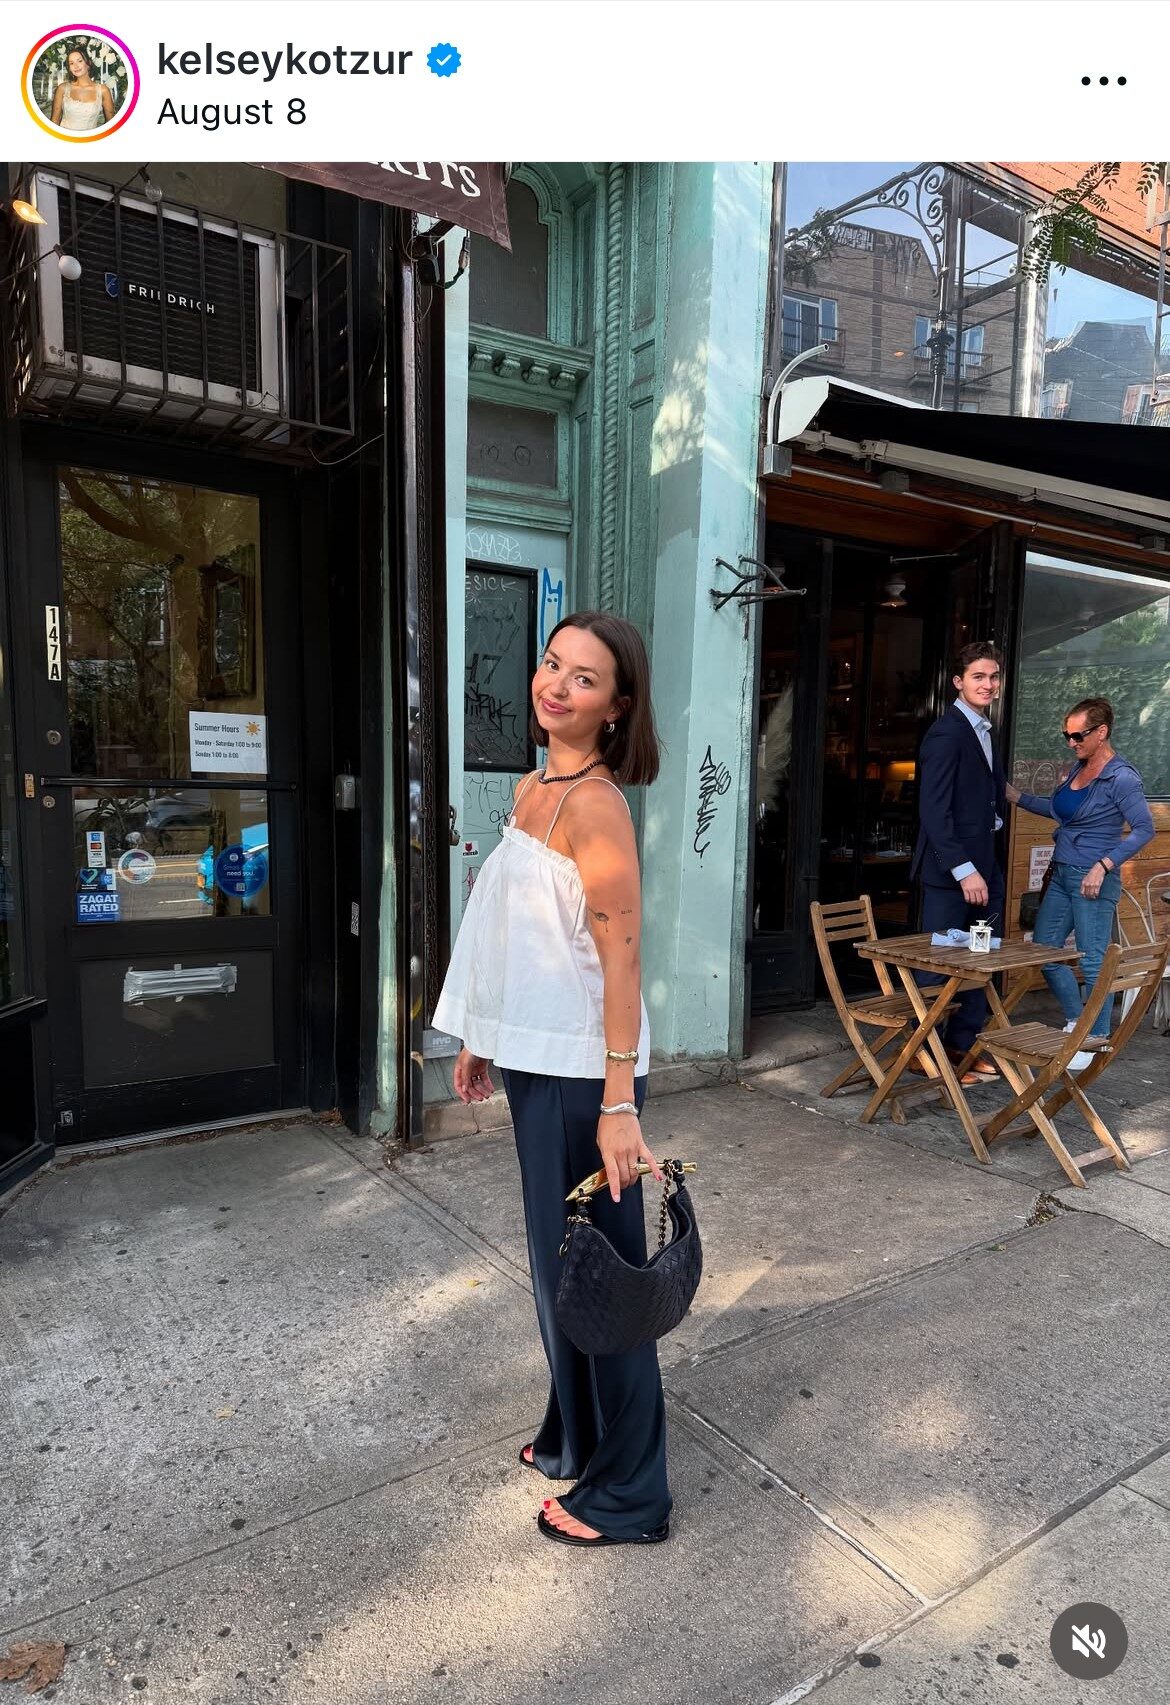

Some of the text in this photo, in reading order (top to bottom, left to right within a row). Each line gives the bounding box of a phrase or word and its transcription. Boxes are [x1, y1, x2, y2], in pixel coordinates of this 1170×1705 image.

[368, 162, 481, 197] ITS
[49, 608, 60, 680] 147A
[194, 723, 240, 733] Summer Hours
[215, 740, 235, 748] Saturday
[79, 894, 119, 904] ZAGAT
[79, 903, 119, 913] RATED
